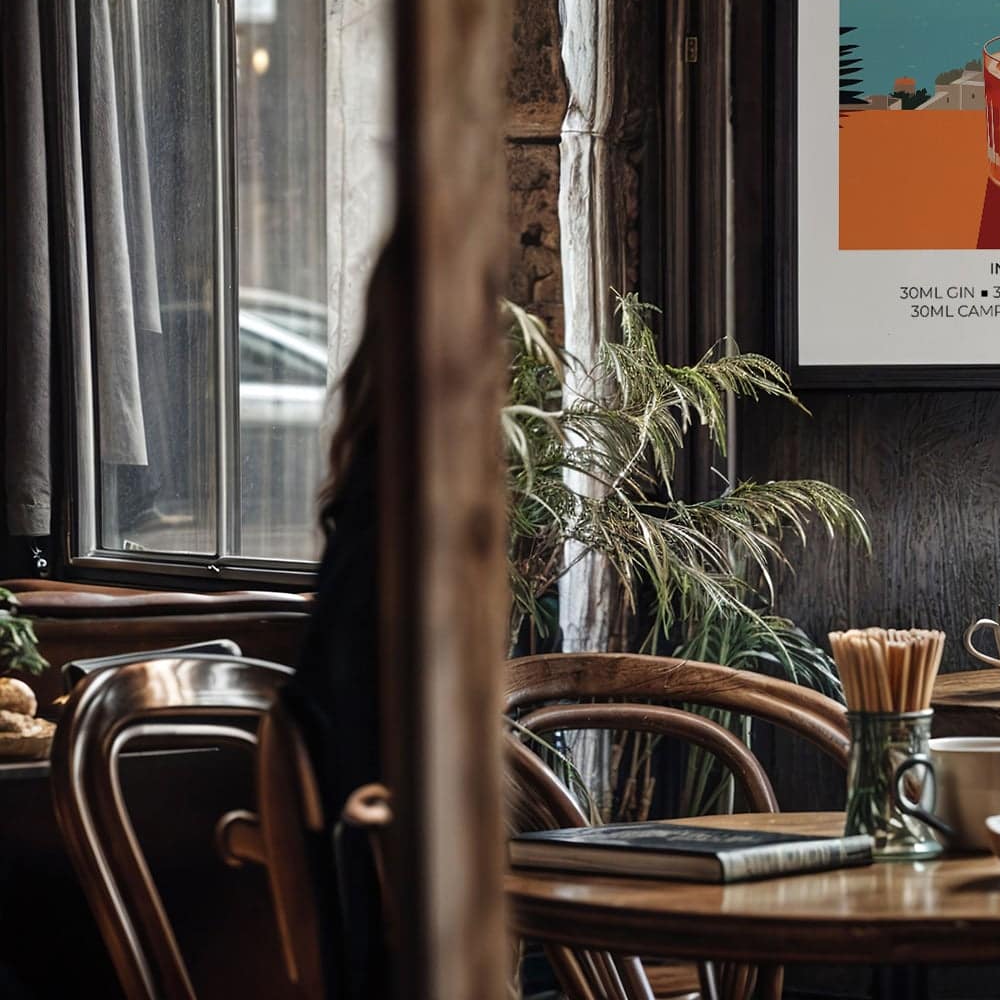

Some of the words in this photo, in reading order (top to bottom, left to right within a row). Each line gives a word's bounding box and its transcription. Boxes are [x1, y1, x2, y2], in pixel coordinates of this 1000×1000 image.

[899, 286, 944, 300] 30ML
[946, 286, 975, 300] GIN
[910, 304, 955, 318] 30ML
